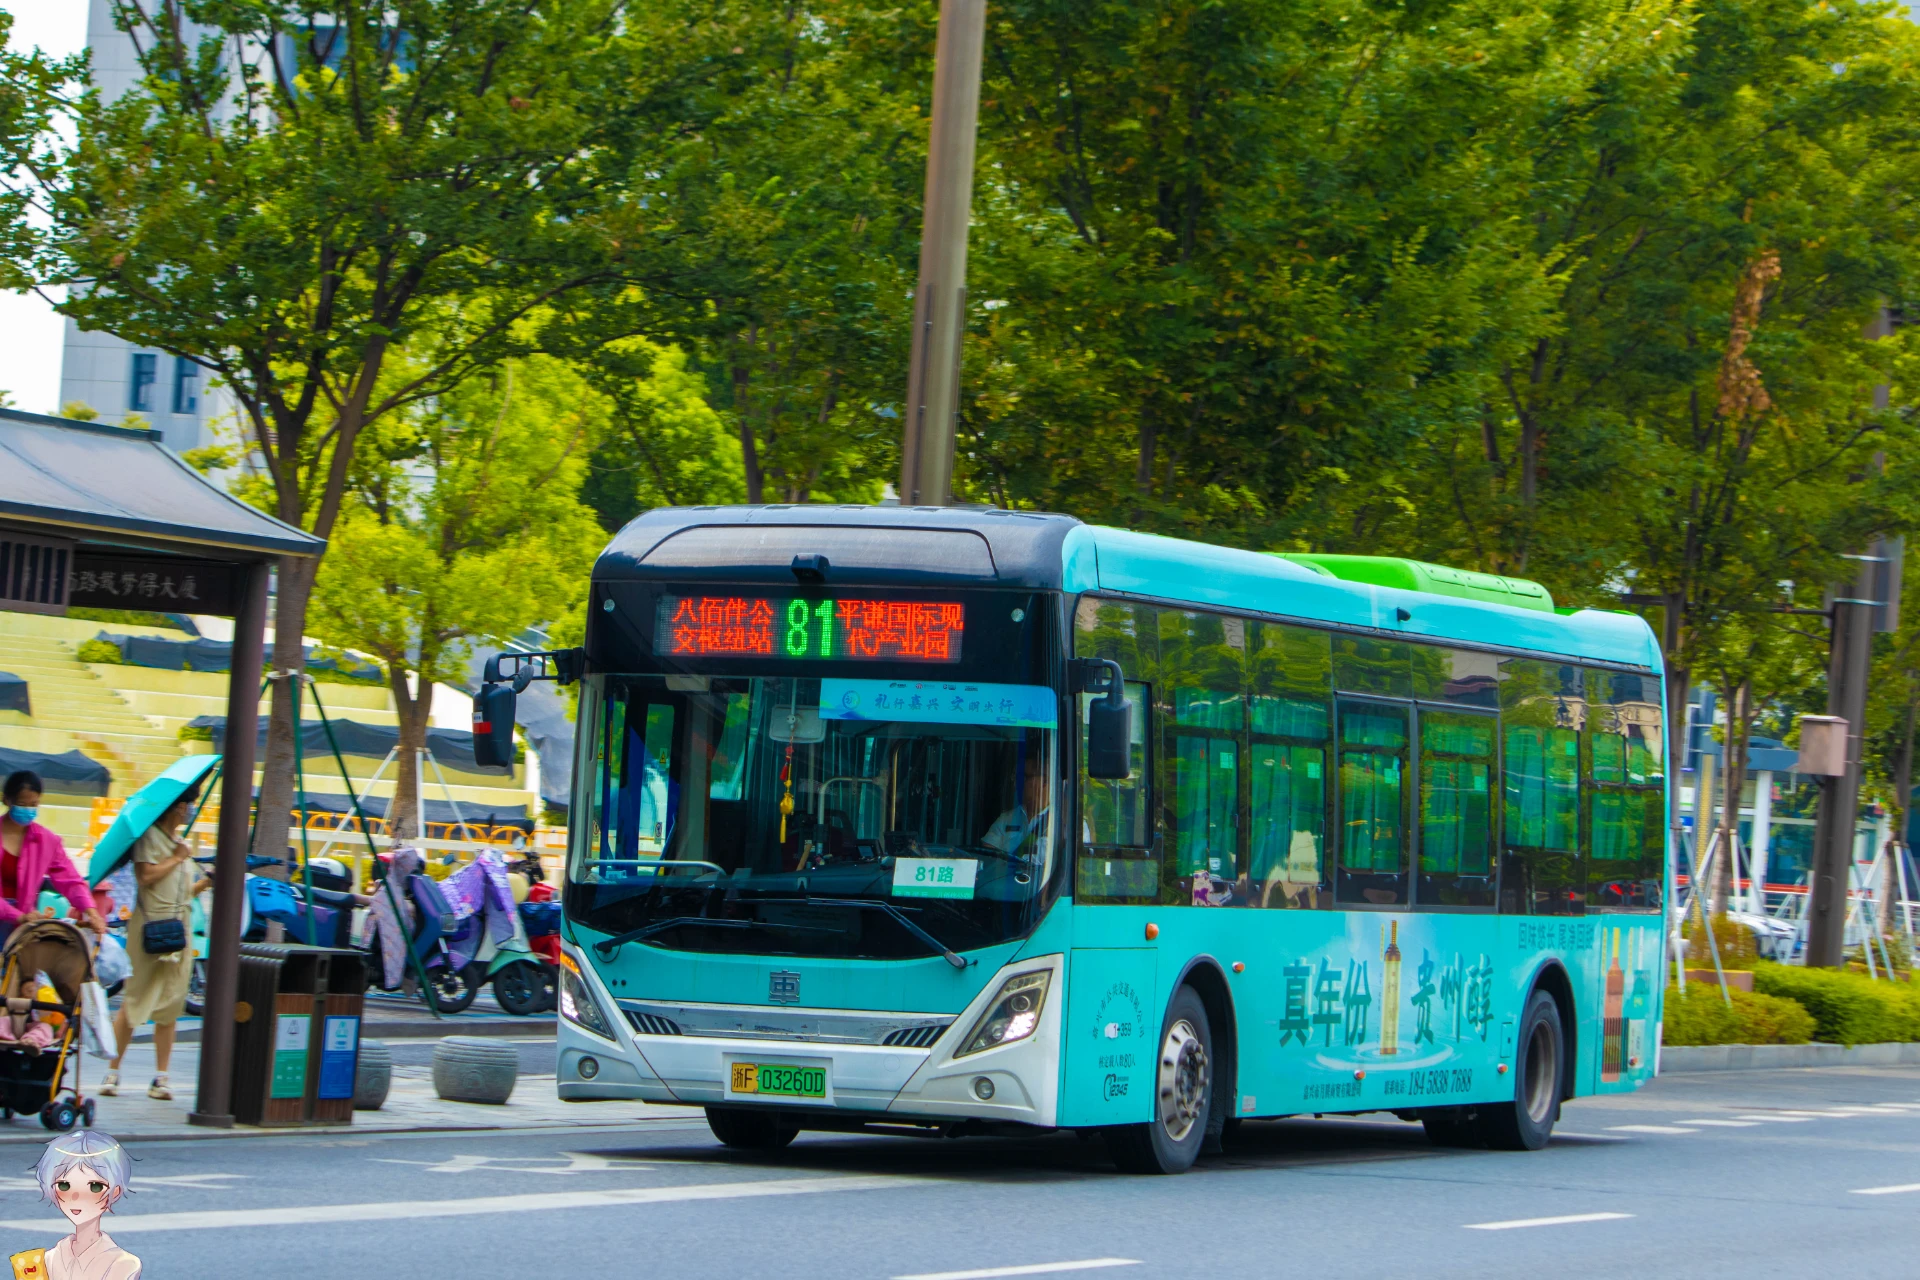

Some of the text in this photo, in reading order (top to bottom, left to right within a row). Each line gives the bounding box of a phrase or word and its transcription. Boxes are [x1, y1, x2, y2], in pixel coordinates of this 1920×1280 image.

[787, 599, 833, 656] 81
[835, 599, 964, 630] 平谦国际现
[846, 627, 950, 659] 代产业园
[915, 866, 954, 883] 81路
[1279, 954, 1372, 1048] 真年份
[1411, 947, 1495, 1045] 贵州醇
[1407, 1071, 1426, 1096] 184
[1426, 1069, 1449, 1095] 5838
[1450, 1068, 1473, 1094] 7688
